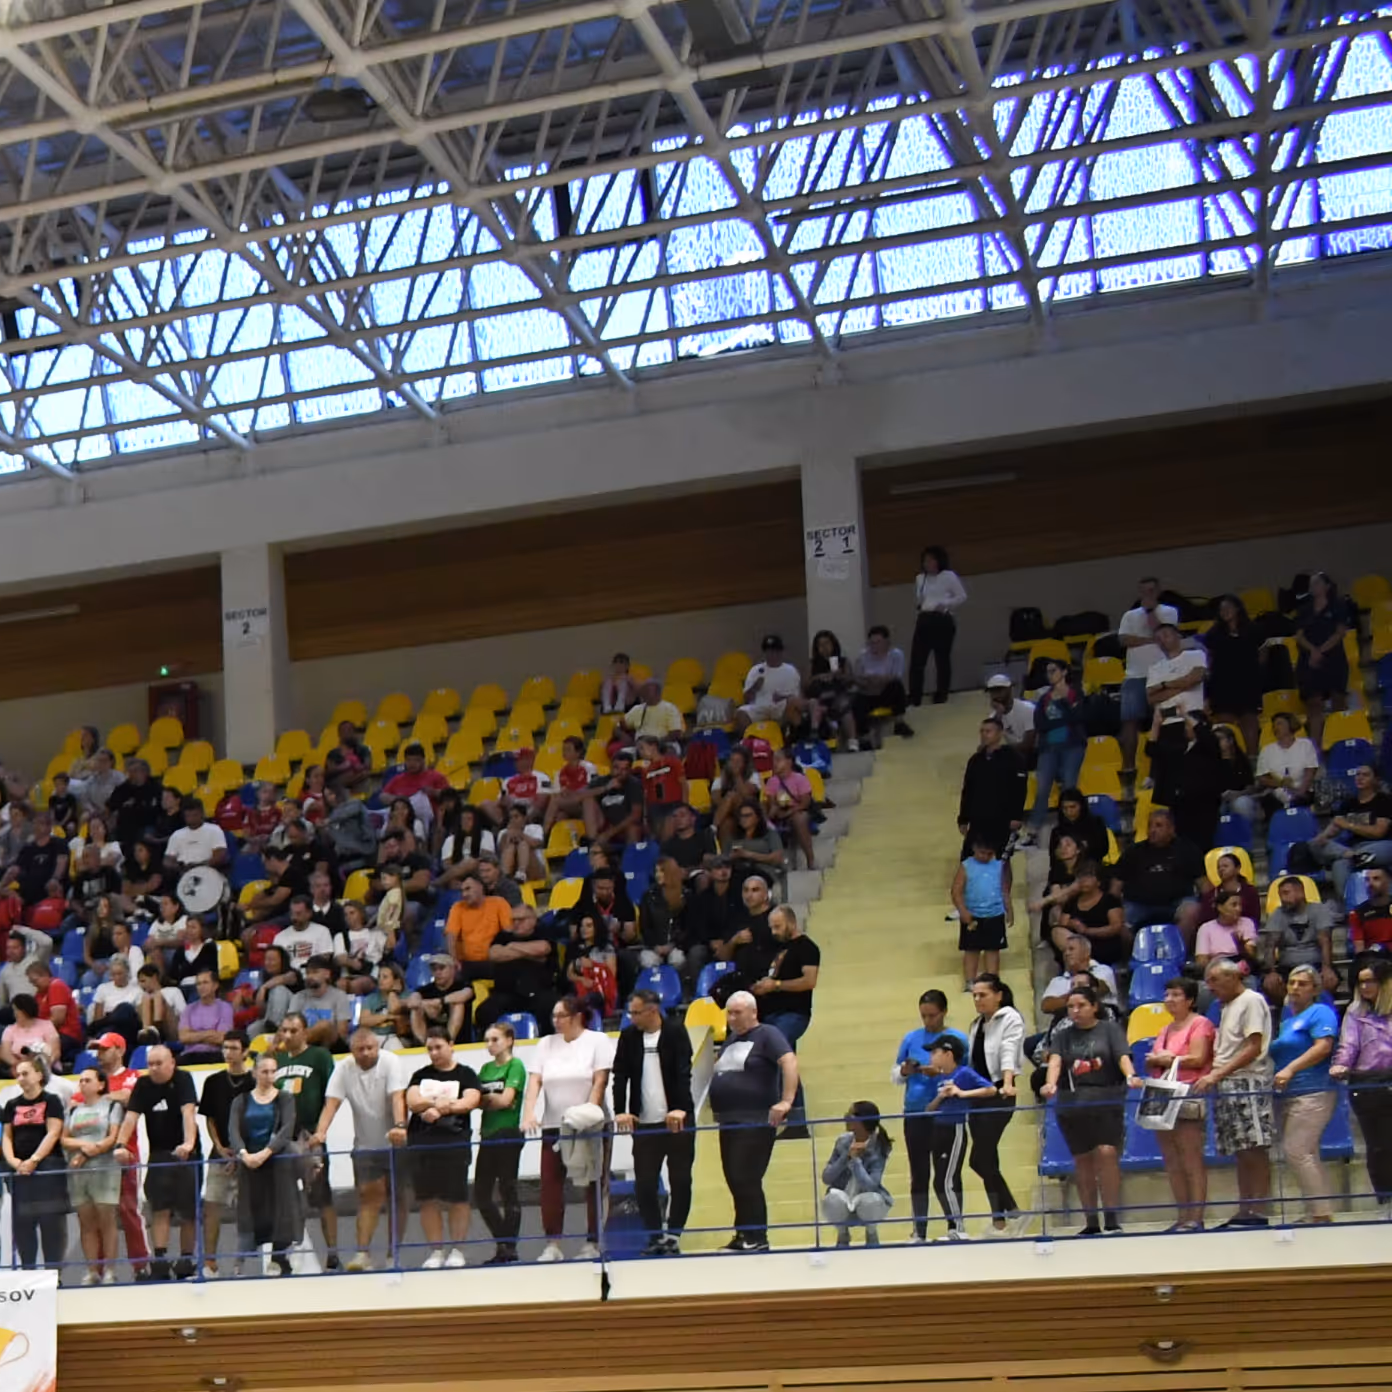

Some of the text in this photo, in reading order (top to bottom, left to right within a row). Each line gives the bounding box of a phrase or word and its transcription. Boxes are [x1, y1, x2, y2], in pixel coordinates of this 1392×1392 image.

[806, 525, 856, 541] SECTOR
[815, 536, 850, 553] 2 1
[224, 608, 267, 621] SECTOR
[242, 622, 250, 635] 2
